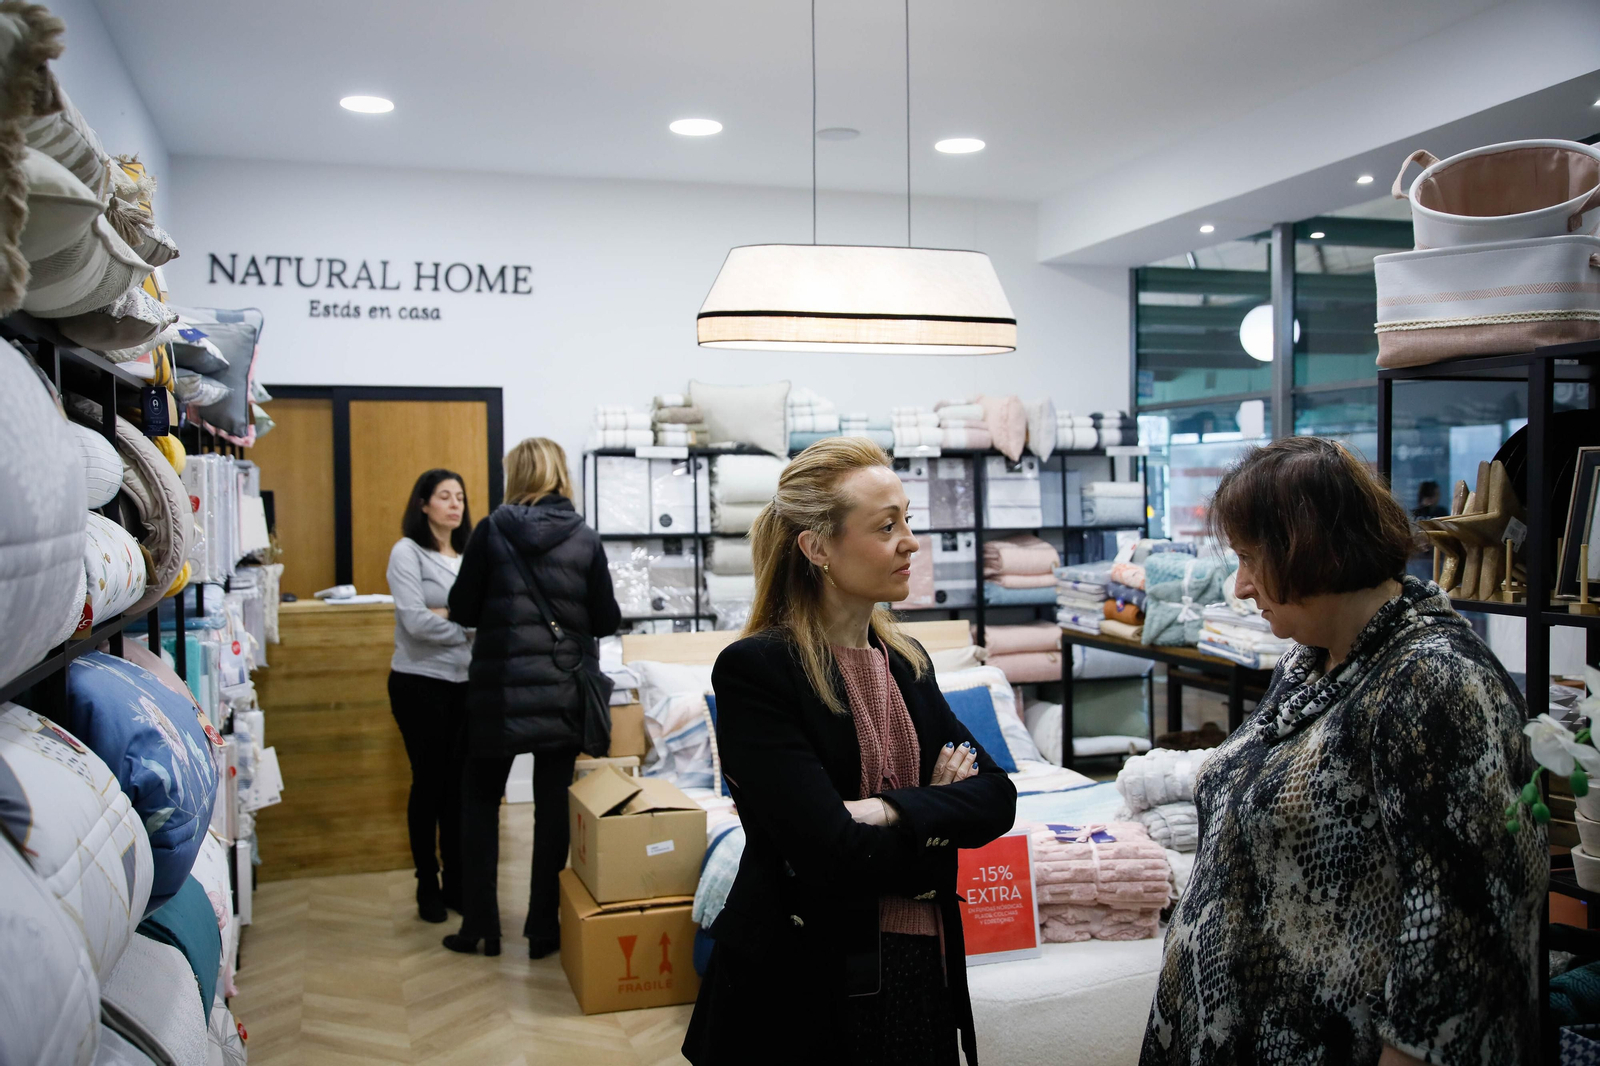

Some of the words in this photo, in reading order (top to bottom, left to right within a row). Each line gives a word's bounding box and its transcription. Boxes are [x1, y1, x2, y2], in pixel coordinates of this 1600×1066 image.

[208, 253, 400, 290] NATURAL
[414, 262, 533, 294] HOME
[309, 300, 361, 319] Estás
[368, 305, 391, 319] en
[398, 306, 441, 320] casa
[972, 865, 1013, 882] -15%
[967, 885, 1022, 904] EXTRA
[618, 979, 672, 993] FRAGILE
